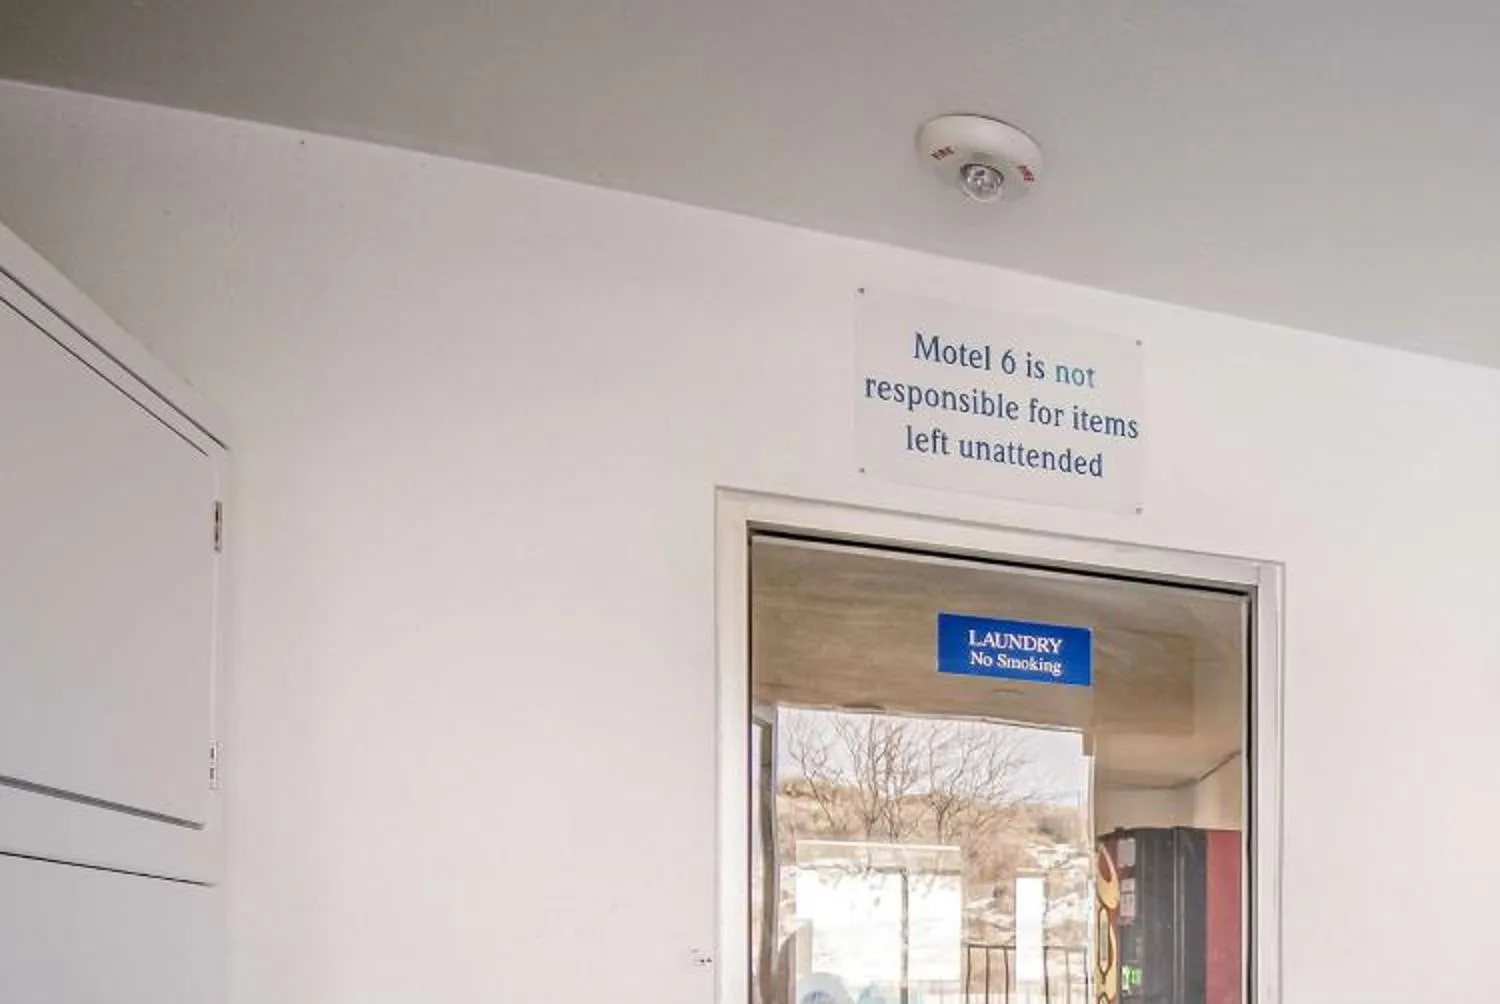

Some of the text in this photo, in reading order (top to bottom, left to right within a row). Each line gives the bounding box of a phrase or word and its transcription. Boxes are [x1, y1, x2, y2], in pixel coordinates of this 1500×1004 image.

[912, 332, 1096, 389] Motel 6 is not
[865, 376, 1139, 439] responsible for items
[905, 425, 1103, 478] left unattended
[968, 629, 1063, 654] LAUNDRY
[970, 651, 1062, 676] No Smoking
